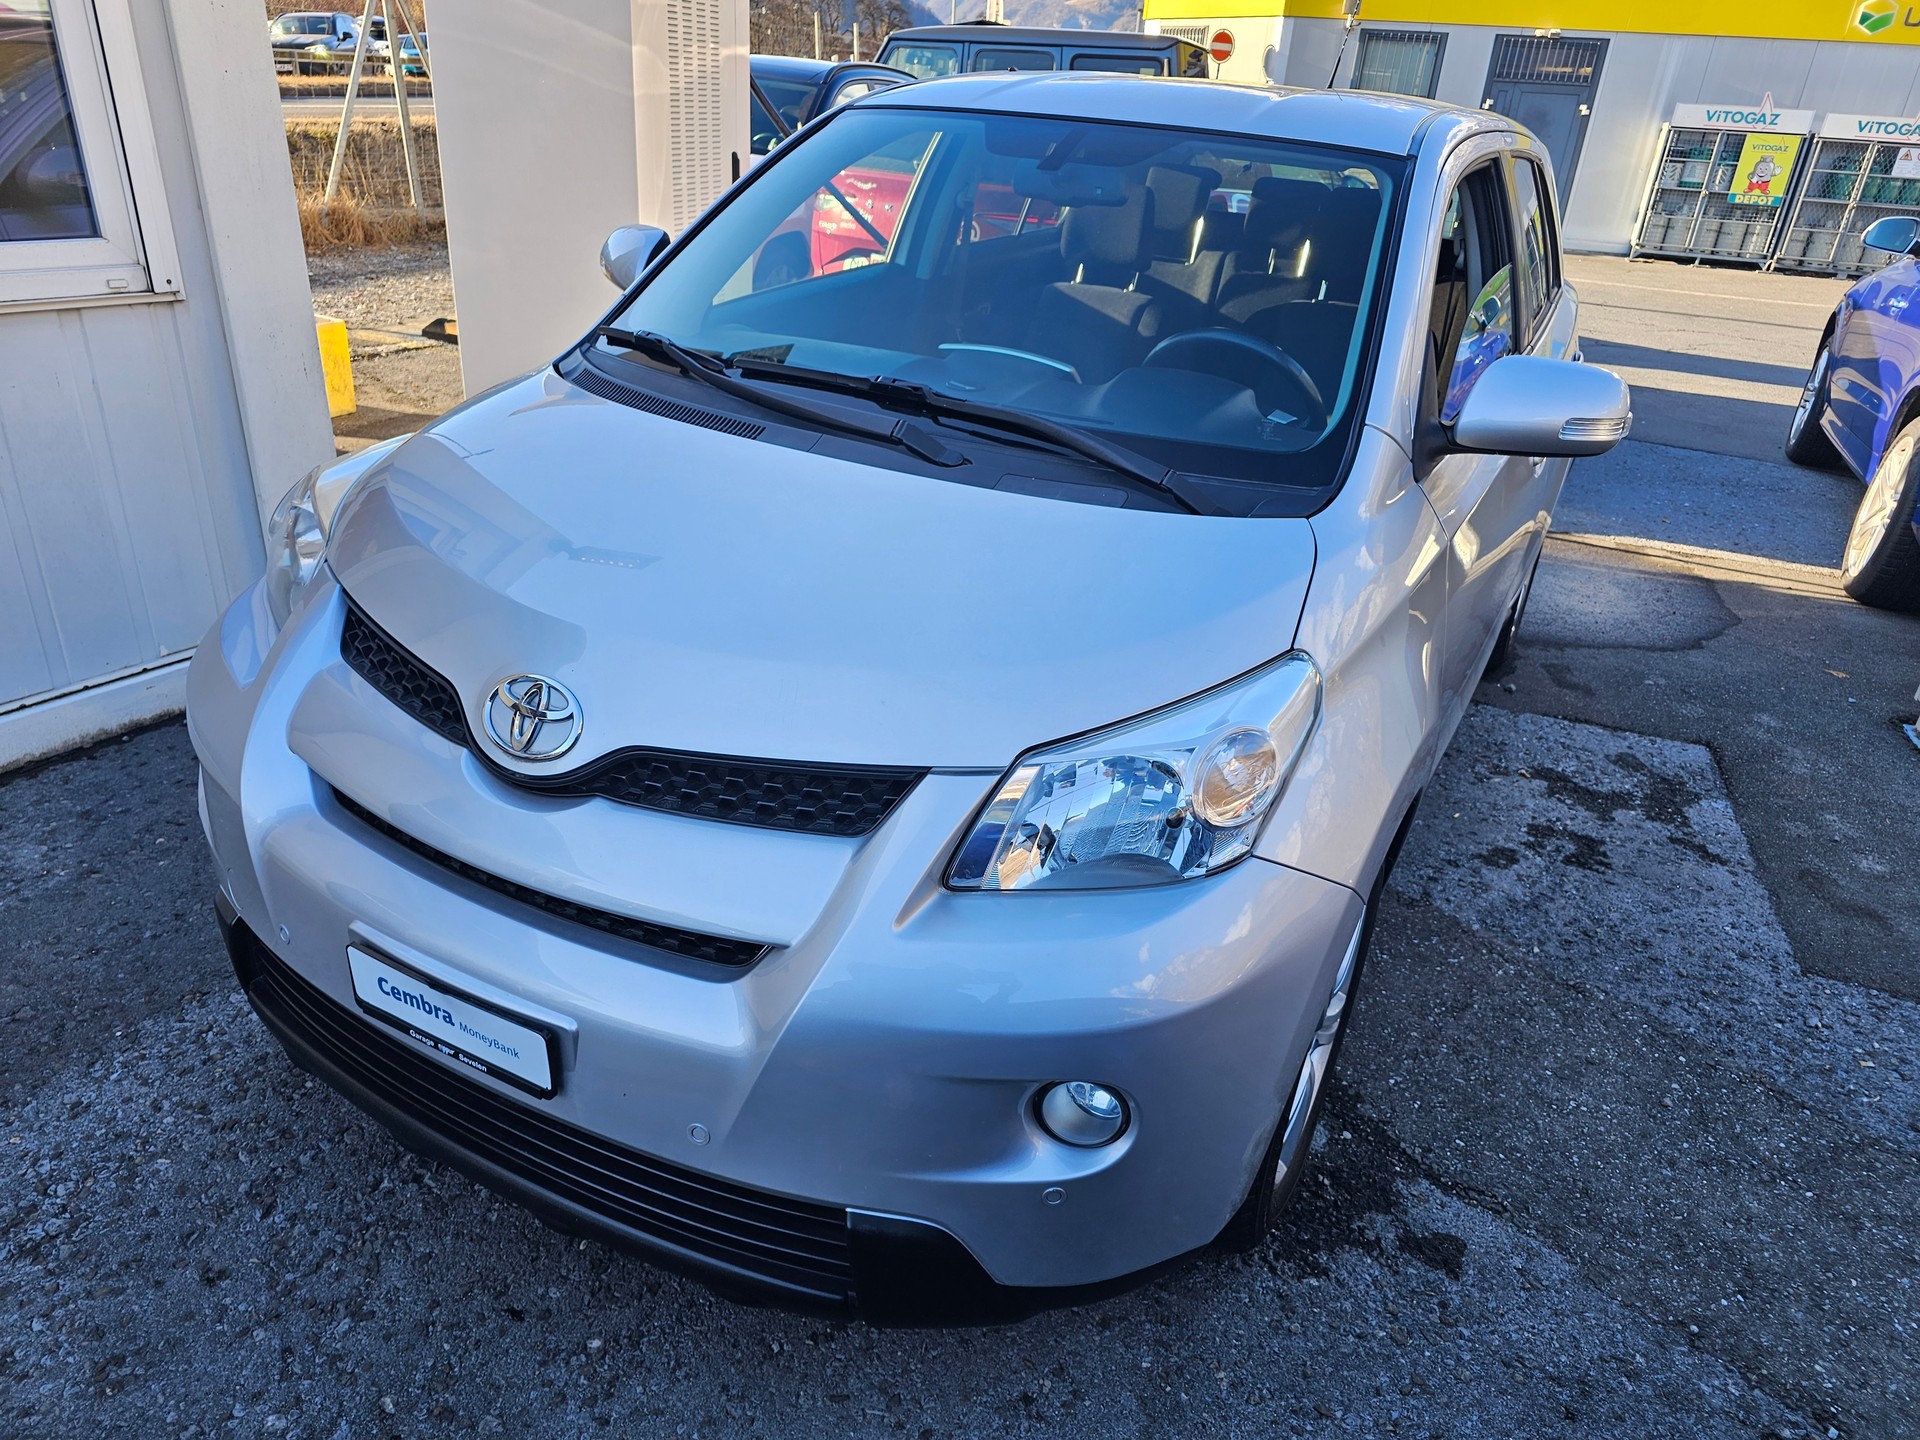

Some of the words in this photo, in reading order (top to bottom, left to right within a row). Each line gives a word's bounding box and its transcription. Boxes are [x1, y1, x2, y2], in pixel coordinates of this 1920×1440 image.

[1904, 6, 1920, 27] L
[1734, 194, 1774, 205] DEPOT
[377, 976, 455, 1027] Cembra
[459, 1021, 521, 1060] MoneyBank
[409, 1029, 435, 1047] Garage
